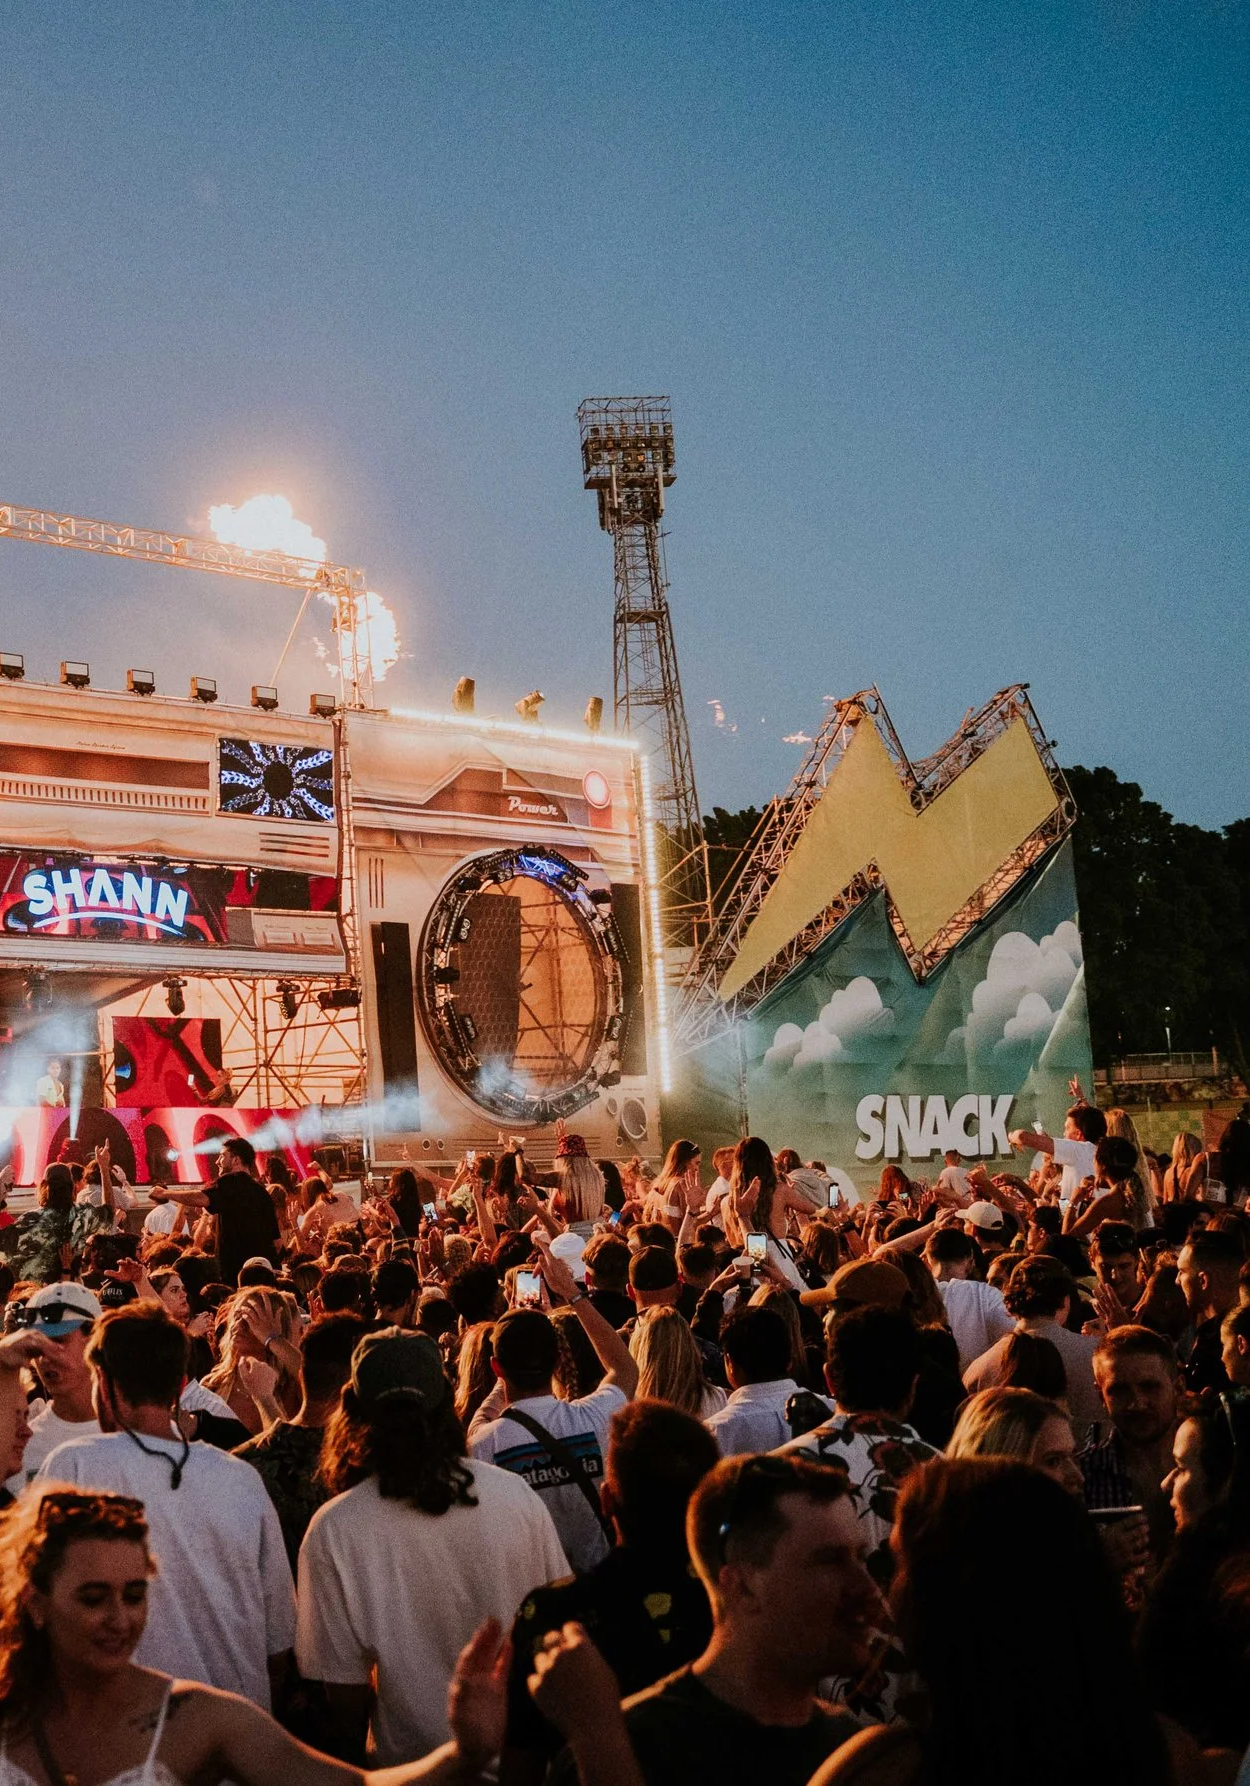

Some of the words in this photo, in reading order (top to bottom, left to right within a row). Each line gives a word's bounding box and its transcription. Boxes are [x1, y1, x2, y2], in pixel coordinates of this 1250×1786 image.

[508, 796, 558, 815] Power
[23, 868, 188, 928] SHANN
[854, 1094, 1016, 1161] SNACK
[522, 1457, 599, 1484] atagoia
